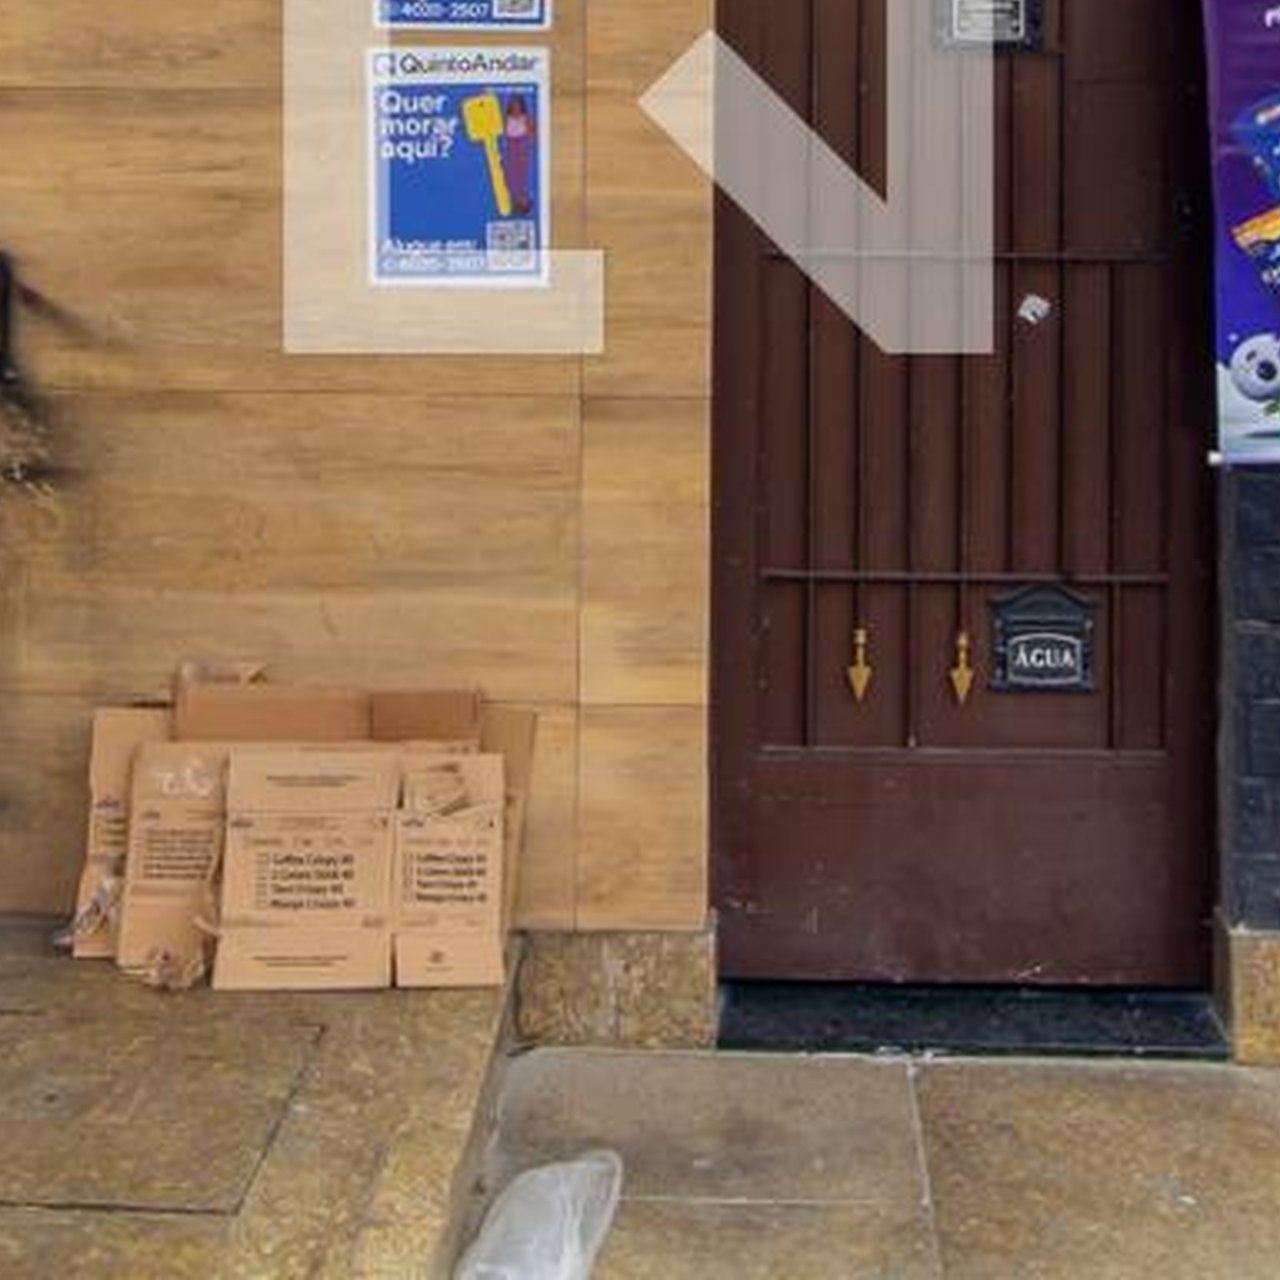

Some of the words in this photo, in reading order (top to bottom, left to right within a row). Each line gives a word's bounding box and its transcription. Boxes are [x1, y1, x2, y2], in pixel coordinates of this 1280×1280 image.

[399, 52, 538, 74] QuintoAndar
[380, 91, 448, 113] Quer
[381, 116, 459, 135] morar
[381, 135, 455, 165] aqui?
